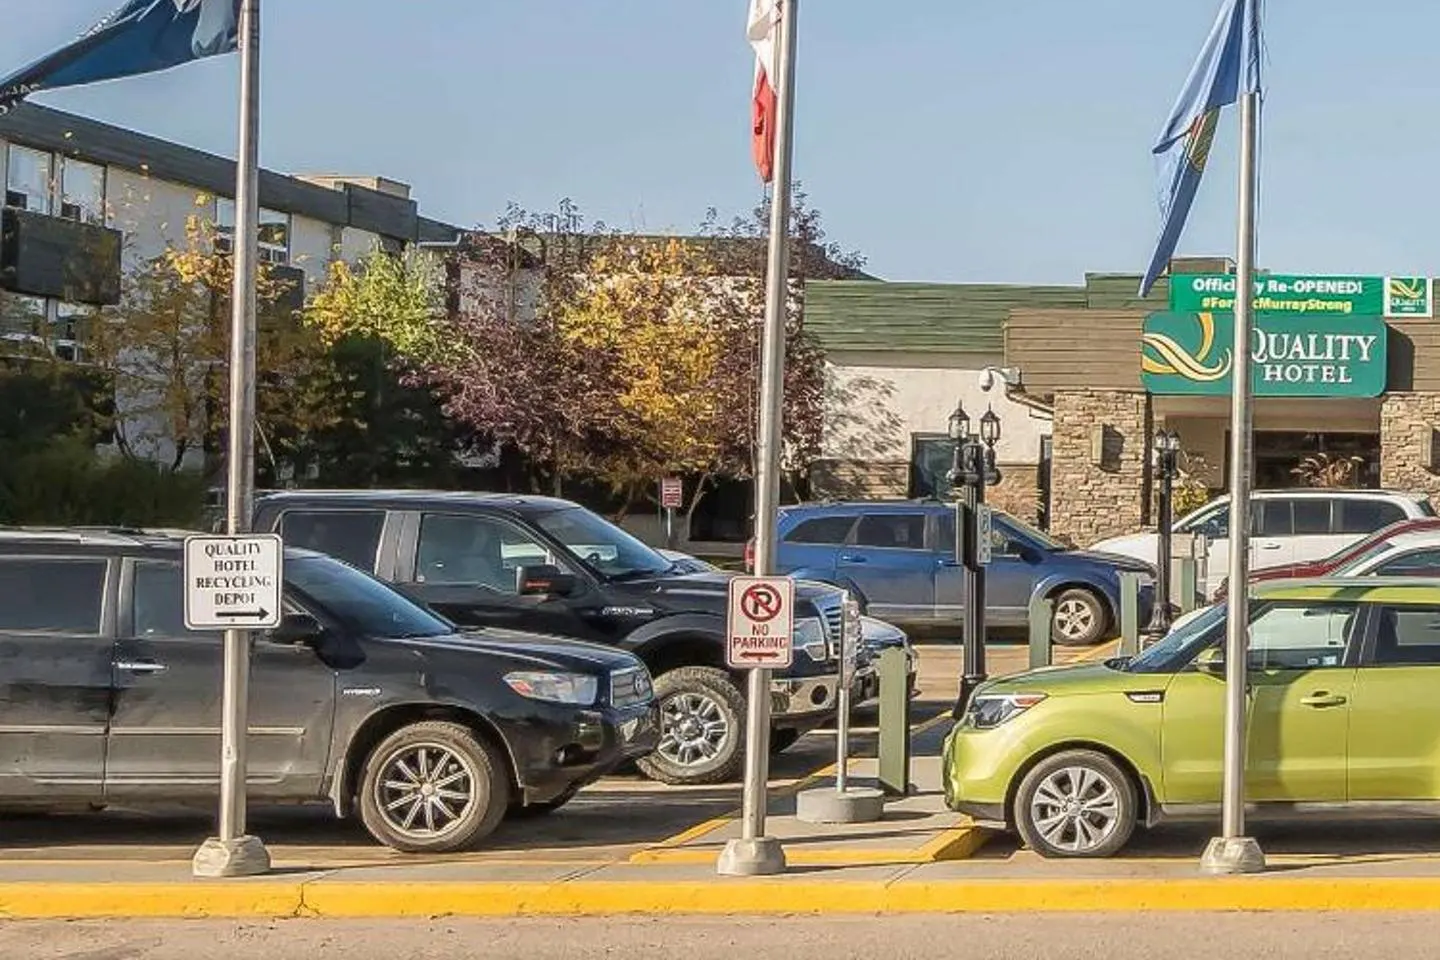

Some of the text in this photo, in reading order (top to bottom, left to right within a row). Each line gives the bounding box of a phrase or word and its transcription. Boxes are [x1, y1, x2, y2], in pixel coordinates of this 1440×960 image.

[1192, 278, 1363, 295] Officiy Re-OPENED!
[1251, 327, 1377, 363] QUALITY
[1263, 363, 1353, 383] HOTEL
[204, 542, 261, 557] QUALITY
[214, 560, 256, 572] HOTEL
[195, 576, 271, 589] RECYCLING
[214, 592, 256, 605] DEPOT
[751, 623, 770, 636] NO
[733, 637, 788, 649] PARKING
